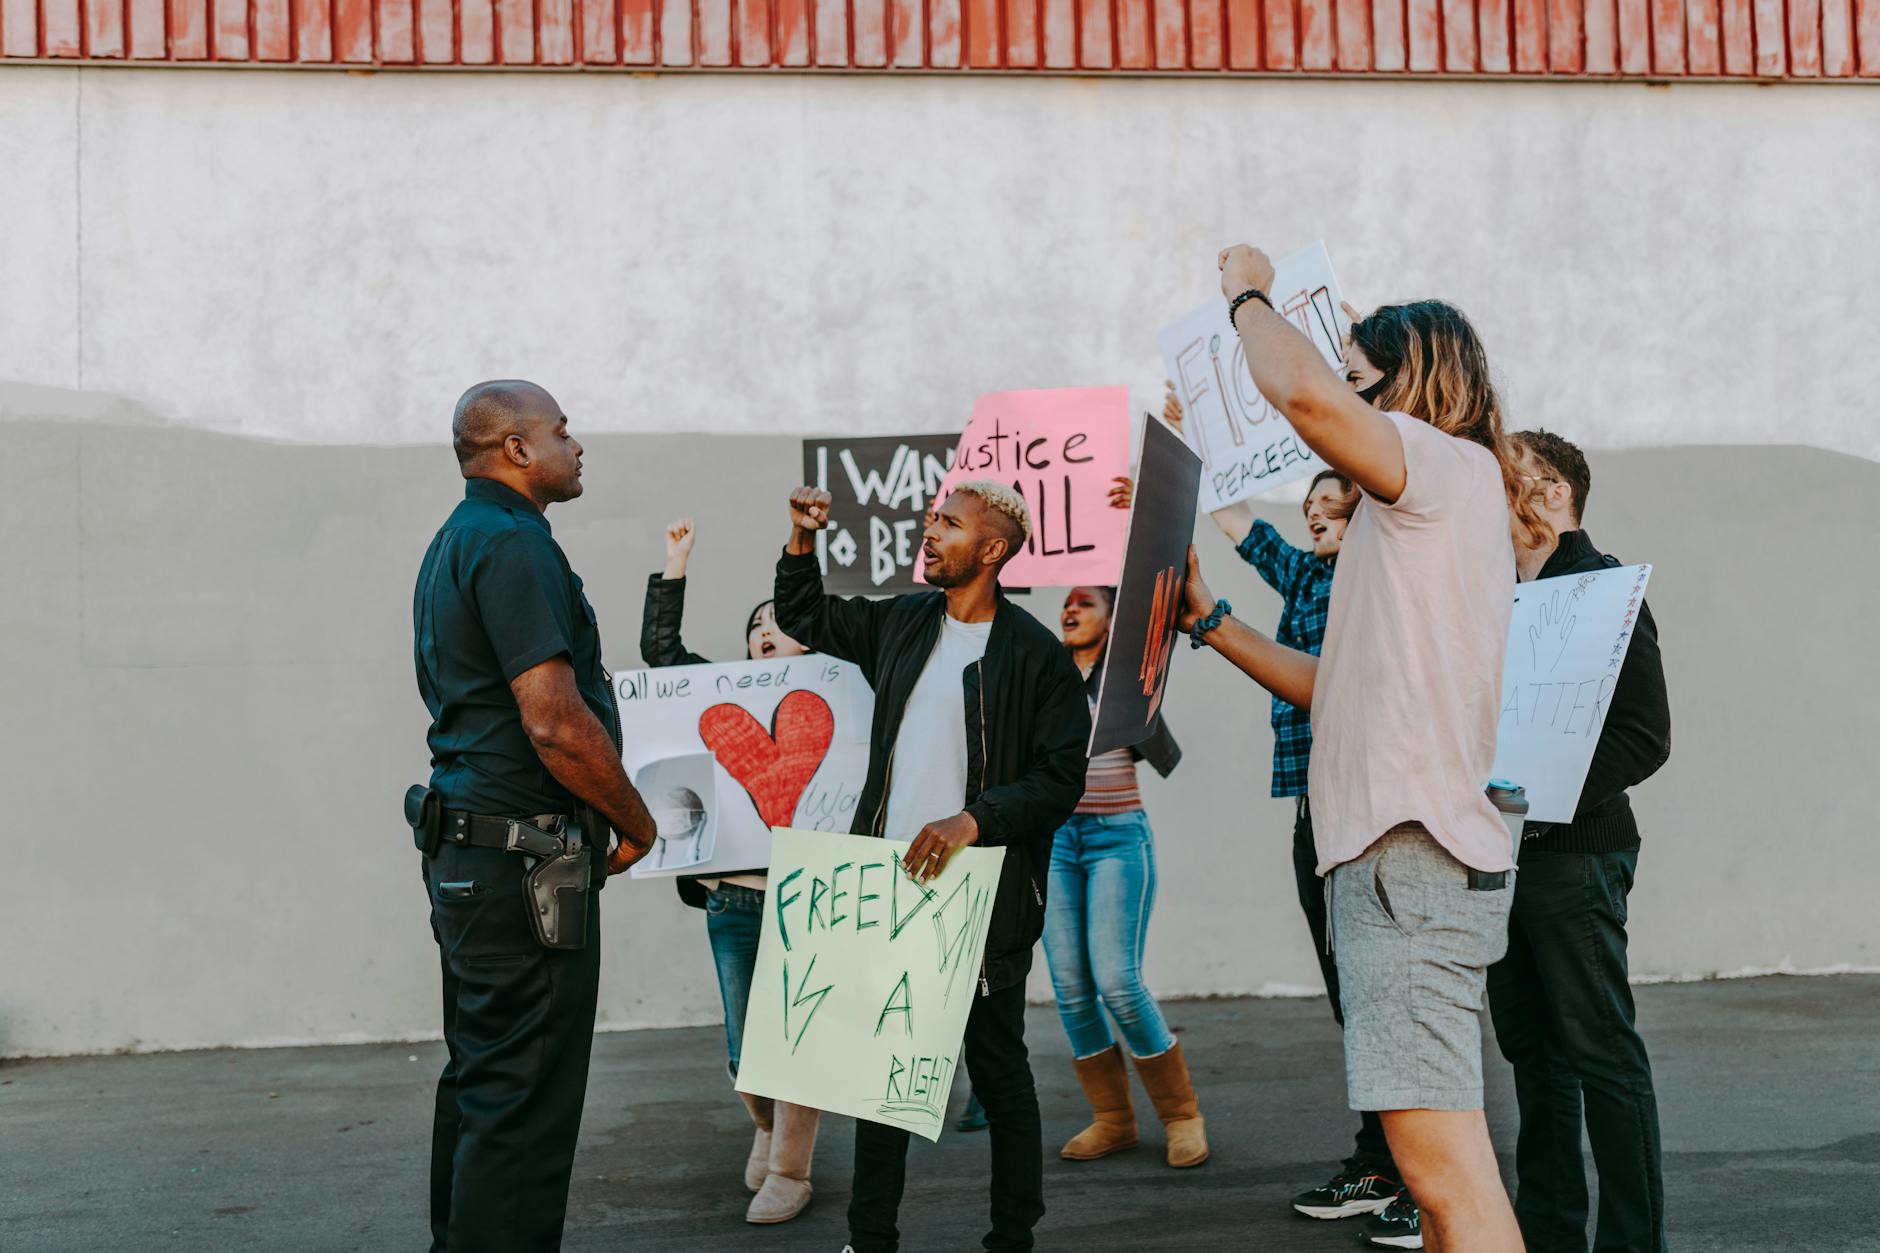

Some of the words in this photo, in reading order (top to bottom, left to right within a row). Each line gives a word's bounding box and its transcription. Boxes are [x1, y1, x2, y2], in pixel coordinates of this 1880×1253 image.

[1176, 286, 1349, 472] FiGT!
[816, 446, 828, 492] I
[869, 515, 917, 586] BE
[618, 672, 648, 700] all
[655, 678, 691, 698] we
[715, 664, 791, 694] need
[819, 661, 841, 682] is
[783, 953, 836, 1056] IS
[873, 971, 914, 1040] A
